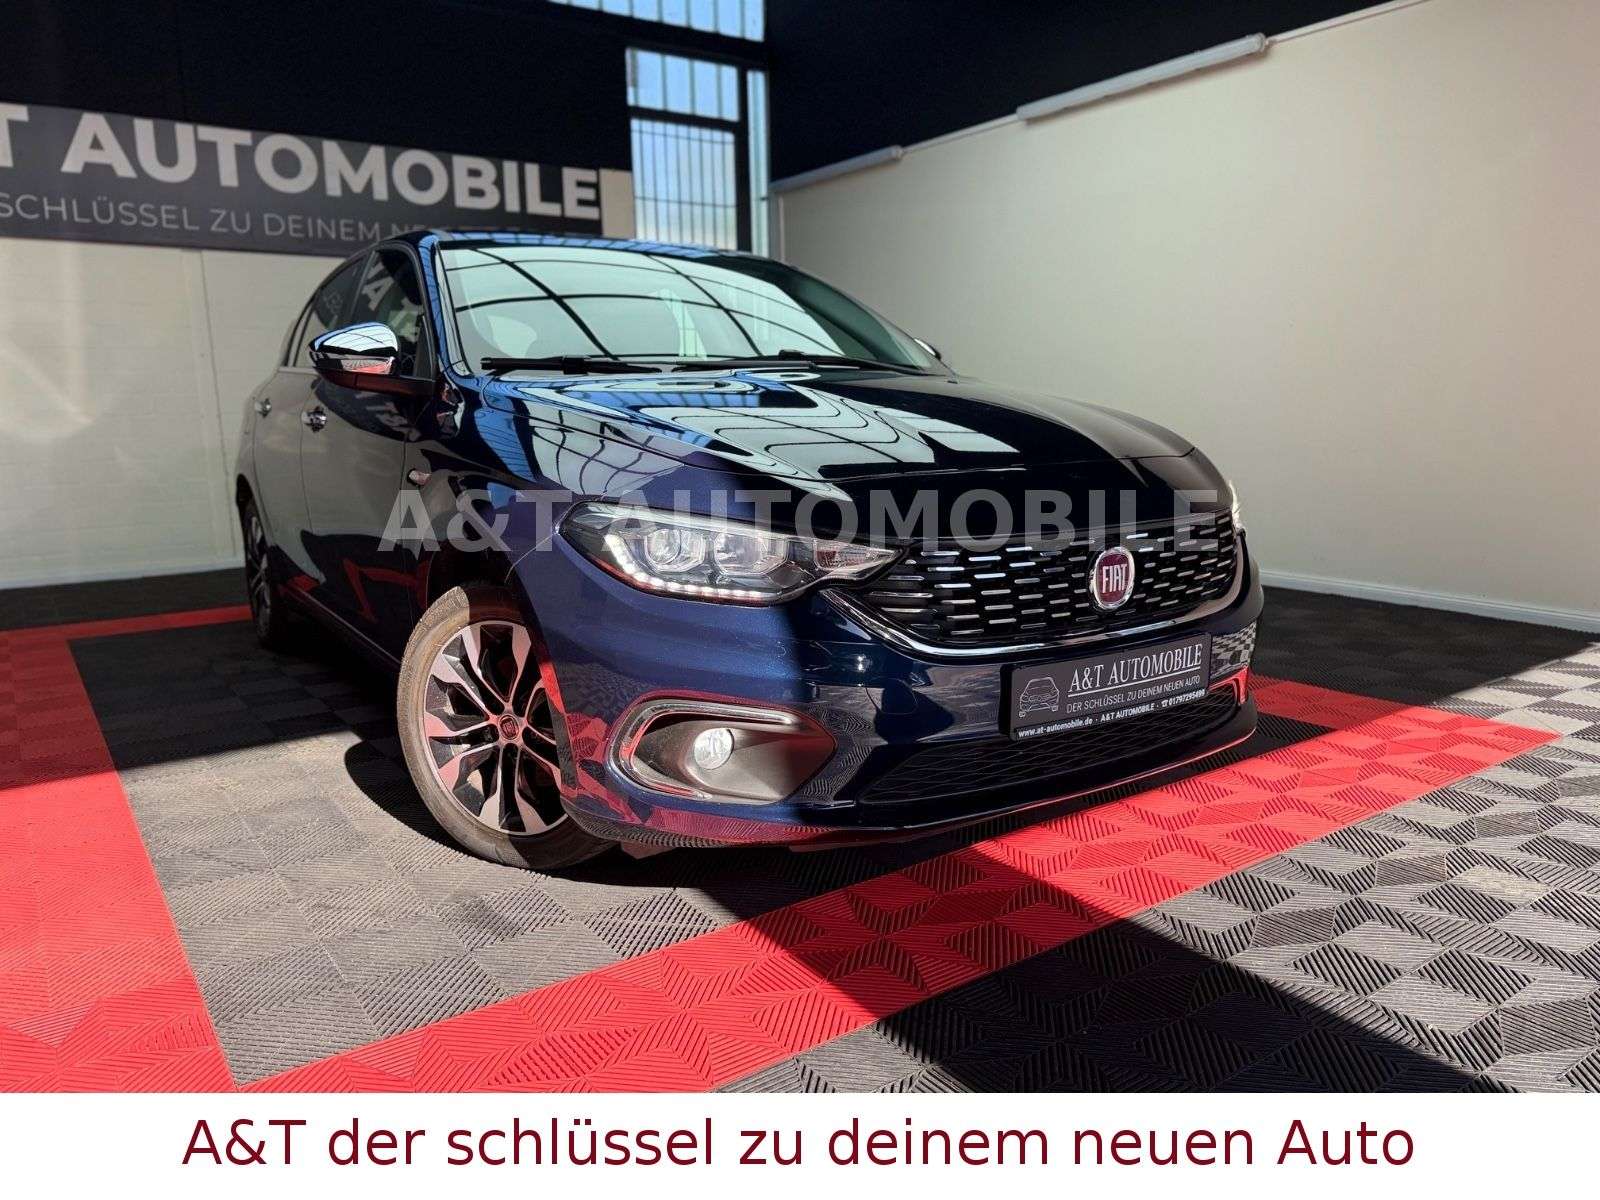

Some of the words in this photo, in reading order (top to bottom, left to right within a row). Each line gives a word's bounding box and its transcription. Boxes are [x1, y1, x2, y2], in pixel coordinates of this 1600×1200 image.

[61, 112, 600, 220] AUTOMOBILE
[0, 193, 200, 230] SCHLÜSSEL
[210, 208, 250, 234] ZU
[263, 213, 382, 241] DEINEM
[1102, 563, 1128, 594] FIAT
[1068, 664, 1105, 693] A&T
[1107, 643, 1203, 686] AUTOMOBILE
[1066, 701, 1083, 714] DER
[1084, 694, 1125, 710] SCHLÜSSEL
[1127, 690, 1137, 701] ZU
[1138, 685, 1163, 700] DEINEM
[1163, 680, 1184, 693] NEUEN
[1185, 674, 1201, 686] AUTO
[1018, 718, 1093, 738] www.at-automobile.de
[1101, 712, 1115, 722] A&T
[1116, 704, 1155, 718] AUTOMOBILE
